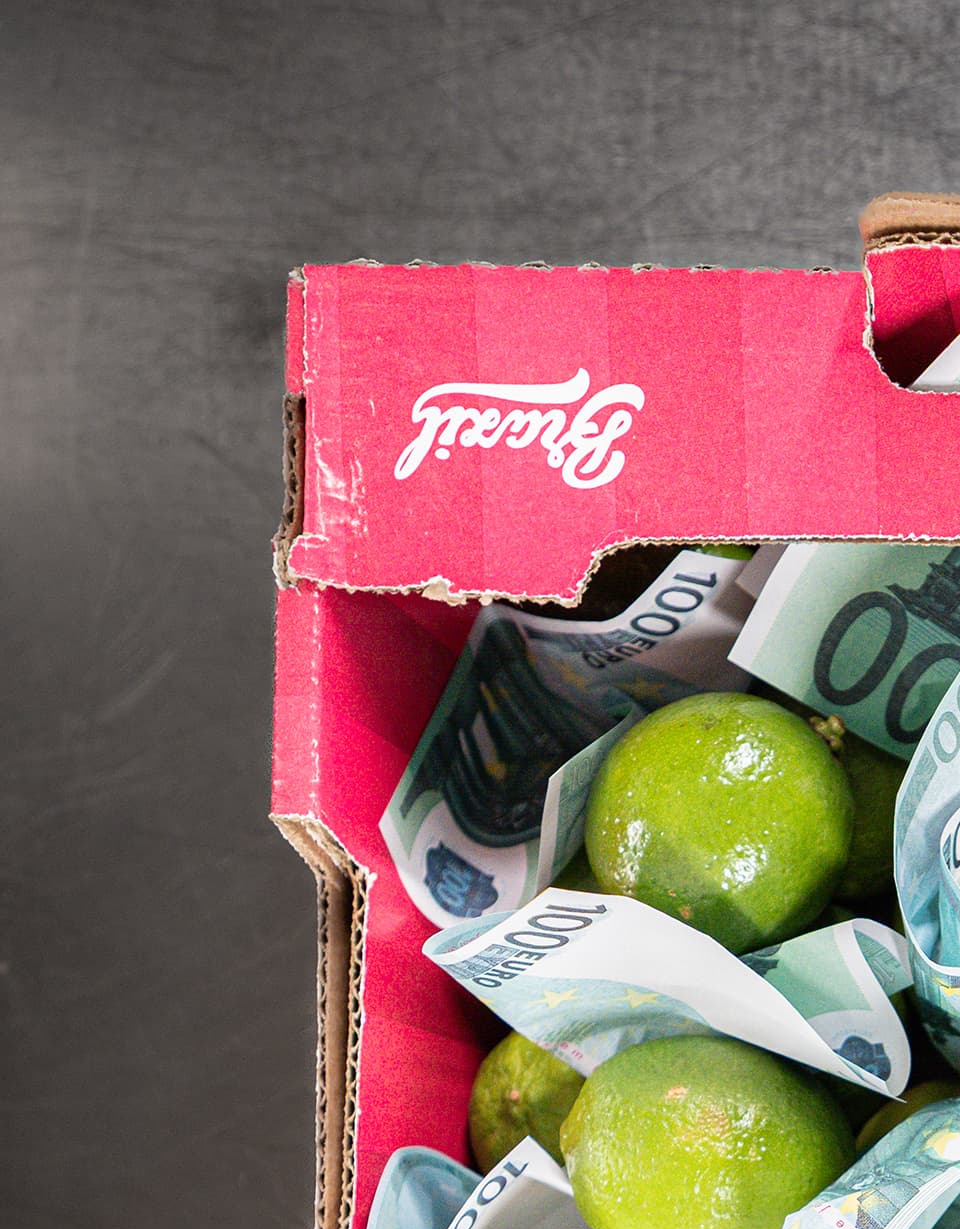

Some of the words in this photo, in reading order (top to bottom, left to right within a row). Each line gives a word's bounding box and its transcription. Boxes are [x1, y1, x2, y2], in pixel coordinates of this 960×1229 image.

[394, 368, 645, 489] Brazil
[629, 572, 717, 637] 100
[582, 637, 658, 669] EURO
[503, 903, 608, 950] 100
[471, 949, 547, 989] EURO
